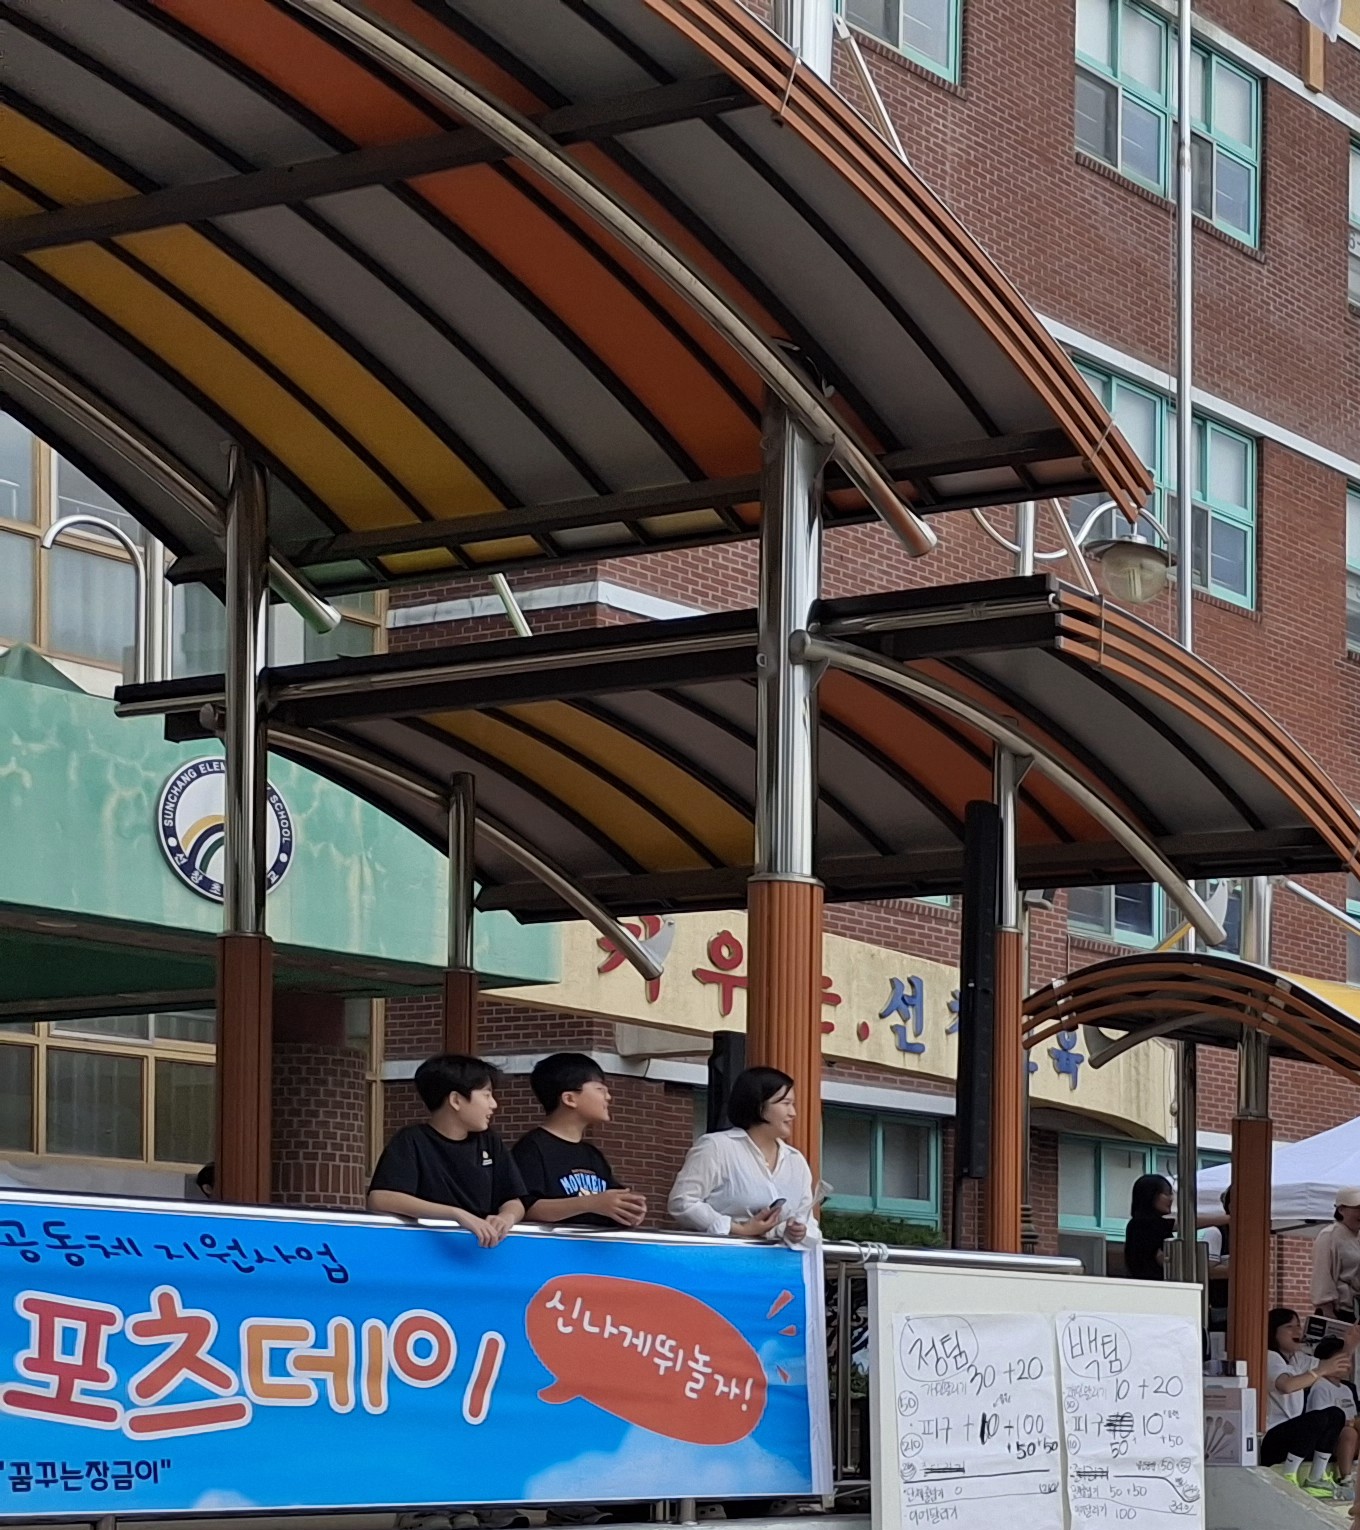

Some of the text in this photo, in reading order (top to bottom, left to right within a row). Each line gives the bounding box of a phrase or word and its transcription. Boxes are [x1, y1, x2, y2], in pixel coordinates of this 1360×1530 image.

[163, 768, 198, 828] SUNCHANG
[270, 794, 292, 844] SCHOOL
[0, 1220, 350, 1284] 공동체 지원사업
[0, 1285, 506, 1441] 포츠데이
[967, 1363, 996, 1396] 30
[1067, 1324, 1123, 1382] 백팀
[1142, 1412, 1164, 1437] 10
[1115, 1507, 1138, 1521] 100
